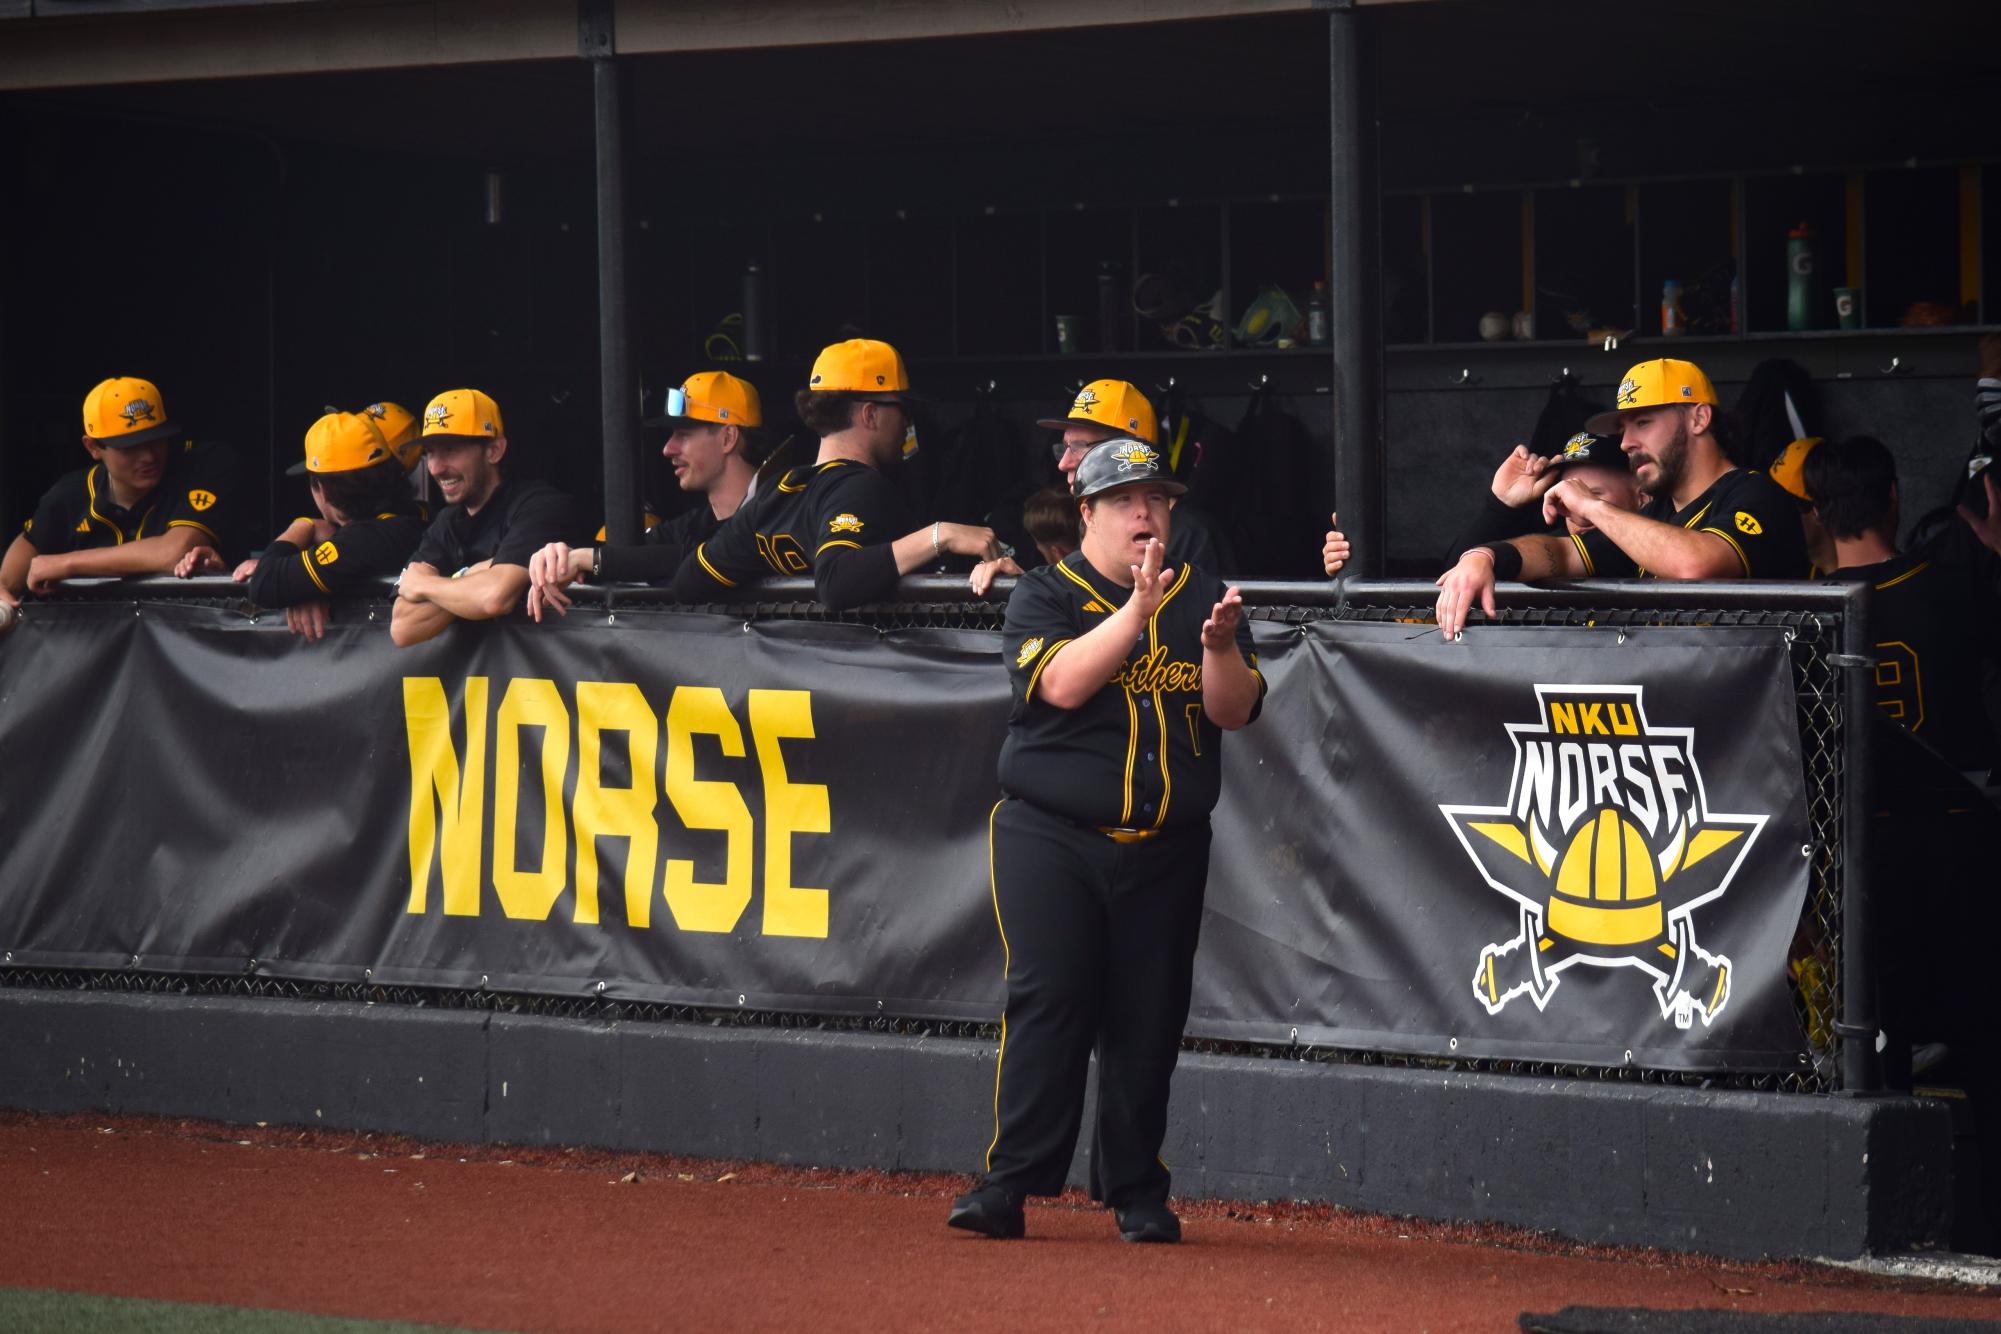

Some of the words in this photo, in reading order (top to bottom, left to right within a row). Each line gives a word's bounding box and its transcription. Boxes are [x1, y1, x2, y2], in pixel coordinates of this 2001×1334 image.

[1836, 295, 1852, 316] G
[1550, 702, 1640, 736] NKU
[1516, 741, 1699, 839] NORSE
[403, 677, 831, 938] NORSE
[1677, 1013, 1689, 1024] TM
